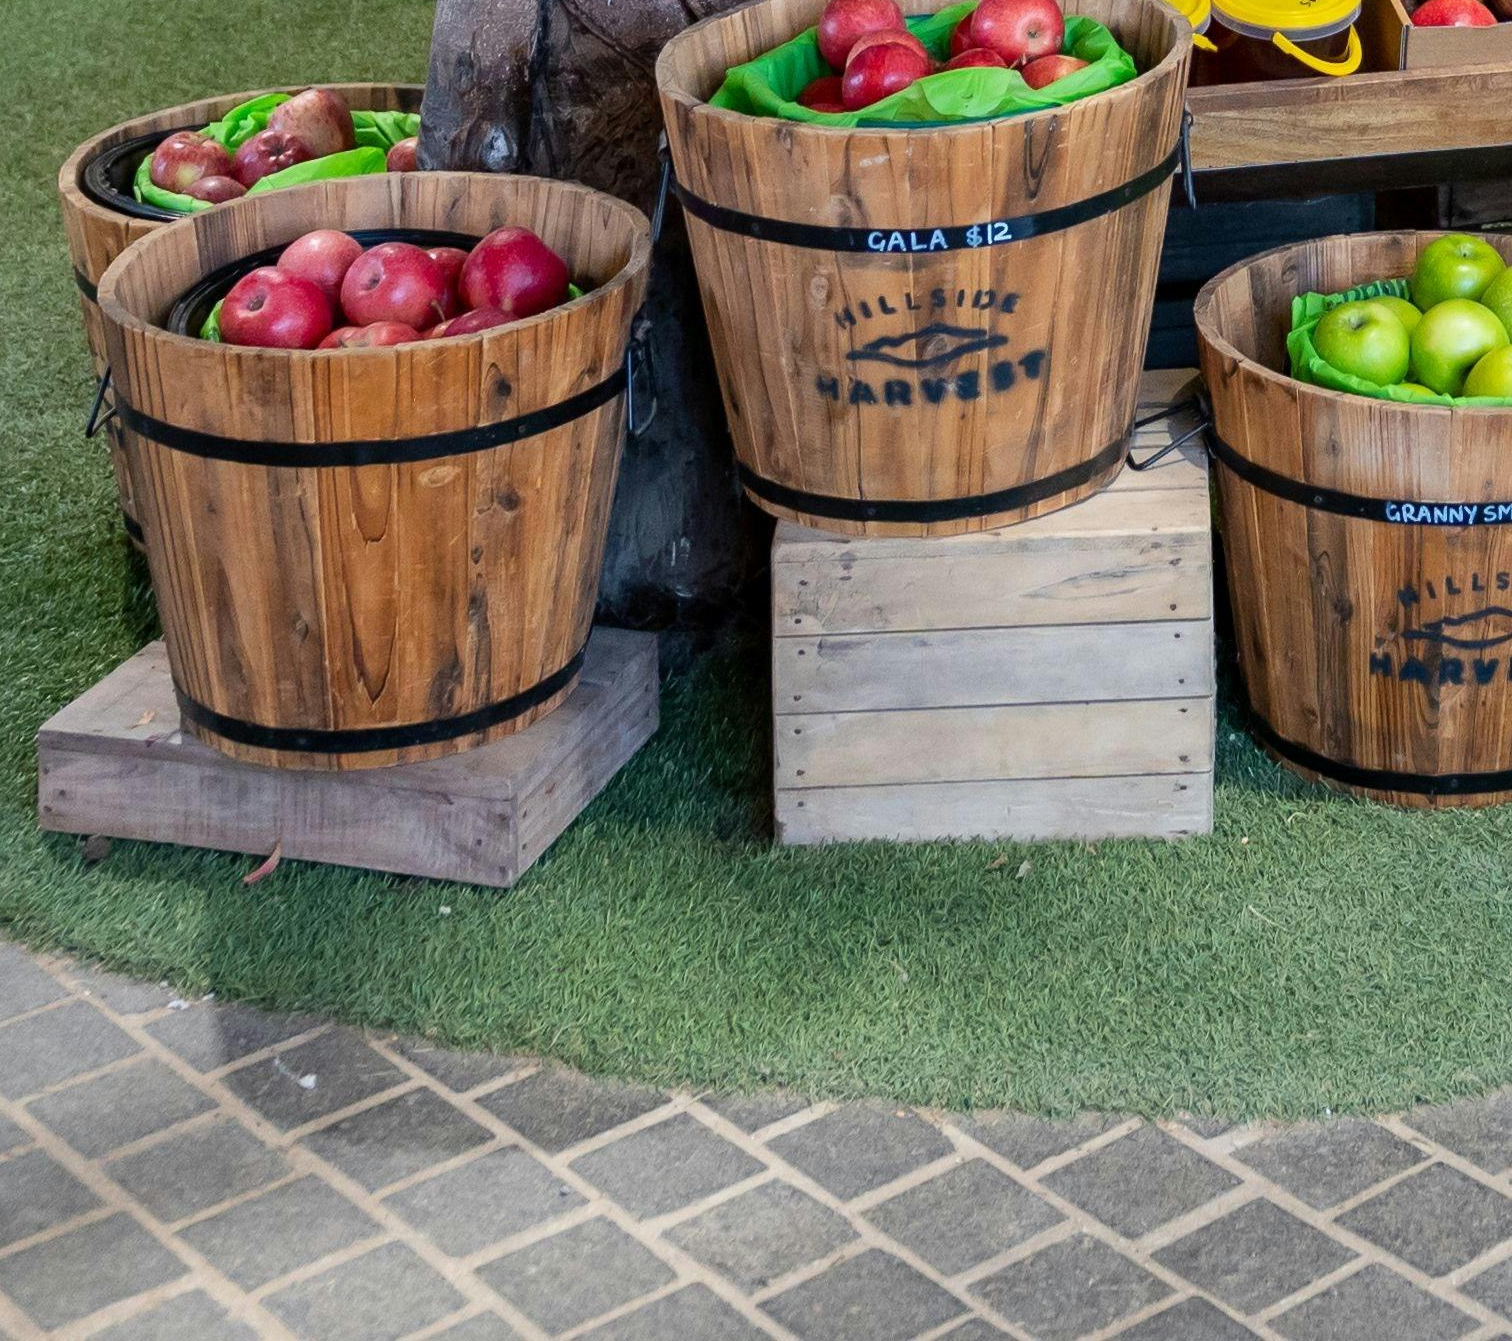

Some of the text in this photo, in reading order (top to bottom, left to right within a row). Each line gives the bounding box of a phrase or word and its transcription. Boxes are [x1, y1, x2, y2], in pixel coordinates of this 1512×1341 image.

[867, 221, 1013, 252] GALA $12
[834, 287, 1022, 330] HILLSIDE
[815, 349, 1047, 406] HARVEST
[1385, 501, 1478, 525] GRANNY
